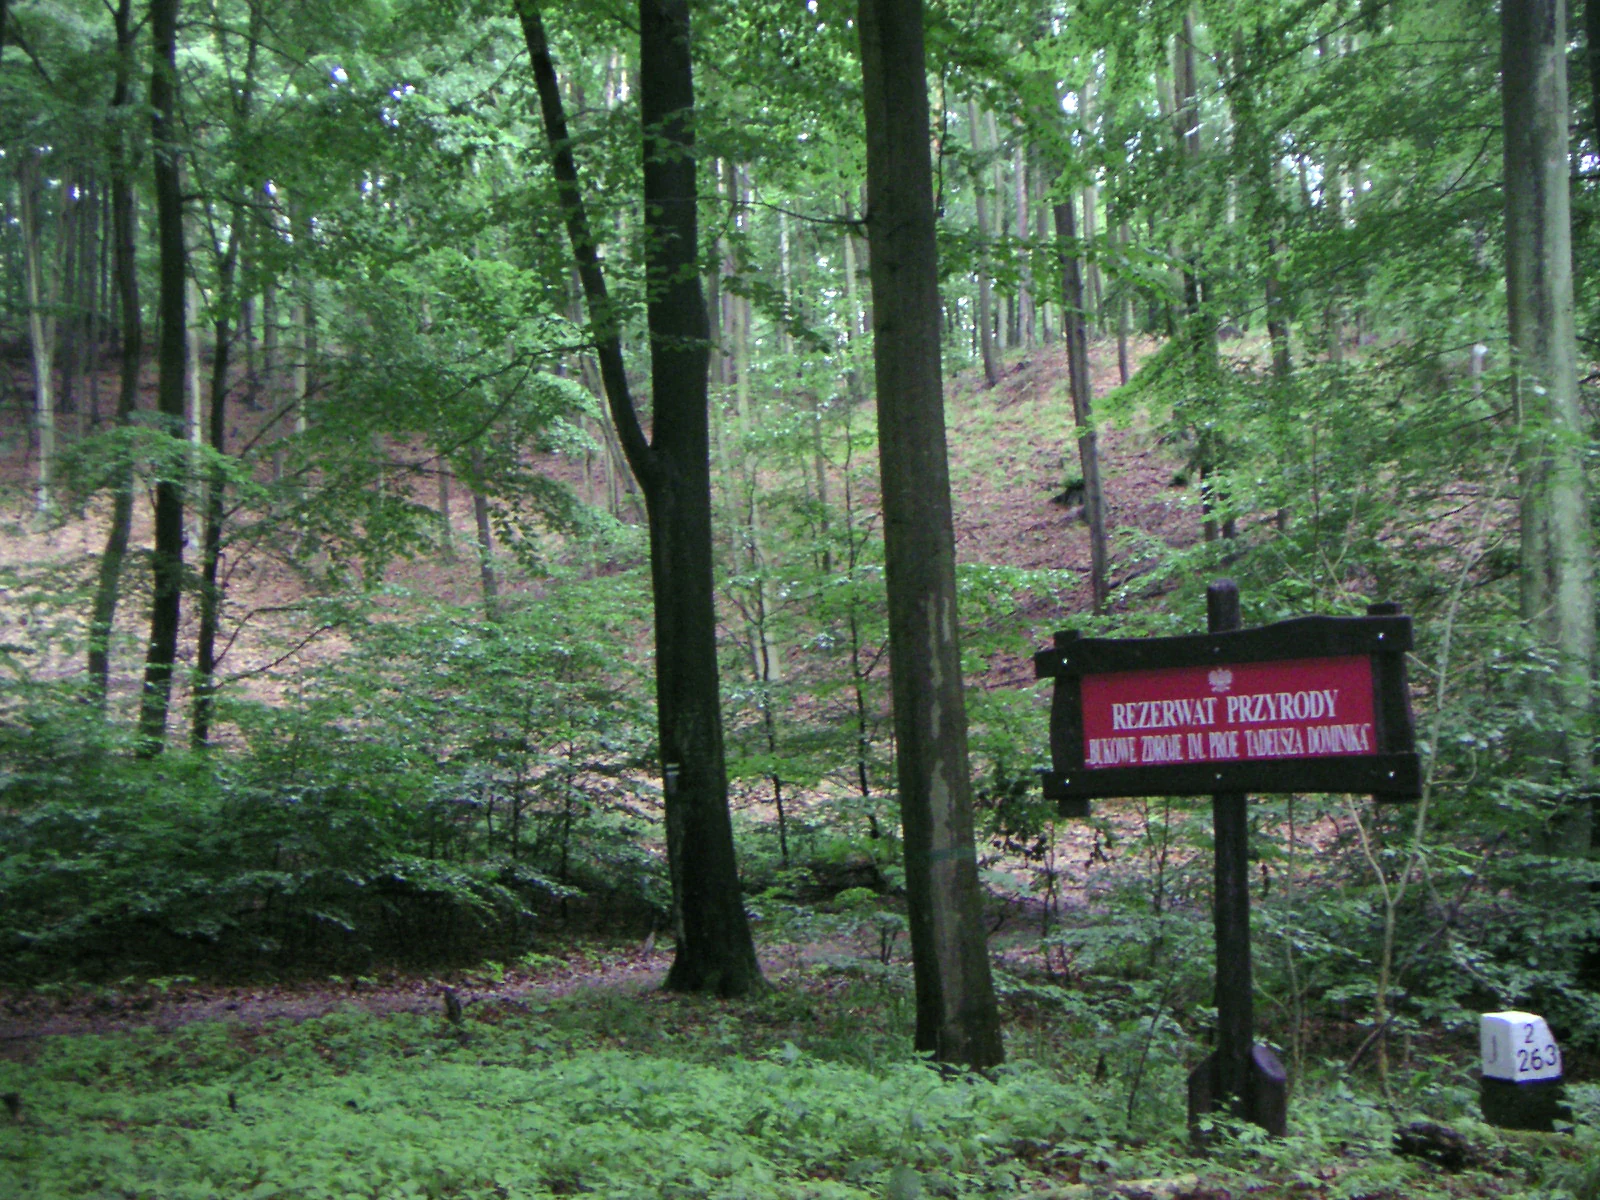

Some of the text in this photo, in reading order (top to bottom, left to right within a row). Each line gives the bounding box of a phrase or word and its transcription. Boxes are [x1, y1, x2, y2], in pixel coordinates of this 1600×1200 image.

[1111, 689, 1339, 730] REZERWAT PRZYRODY
[1141, 734, 1183, 762] ZDROJE
[1244, 727, 1304, 756] TADEUSZA
[1523, 1023, 1534, 1043] 2
[1518, 1044, 1557, 1072] 263
